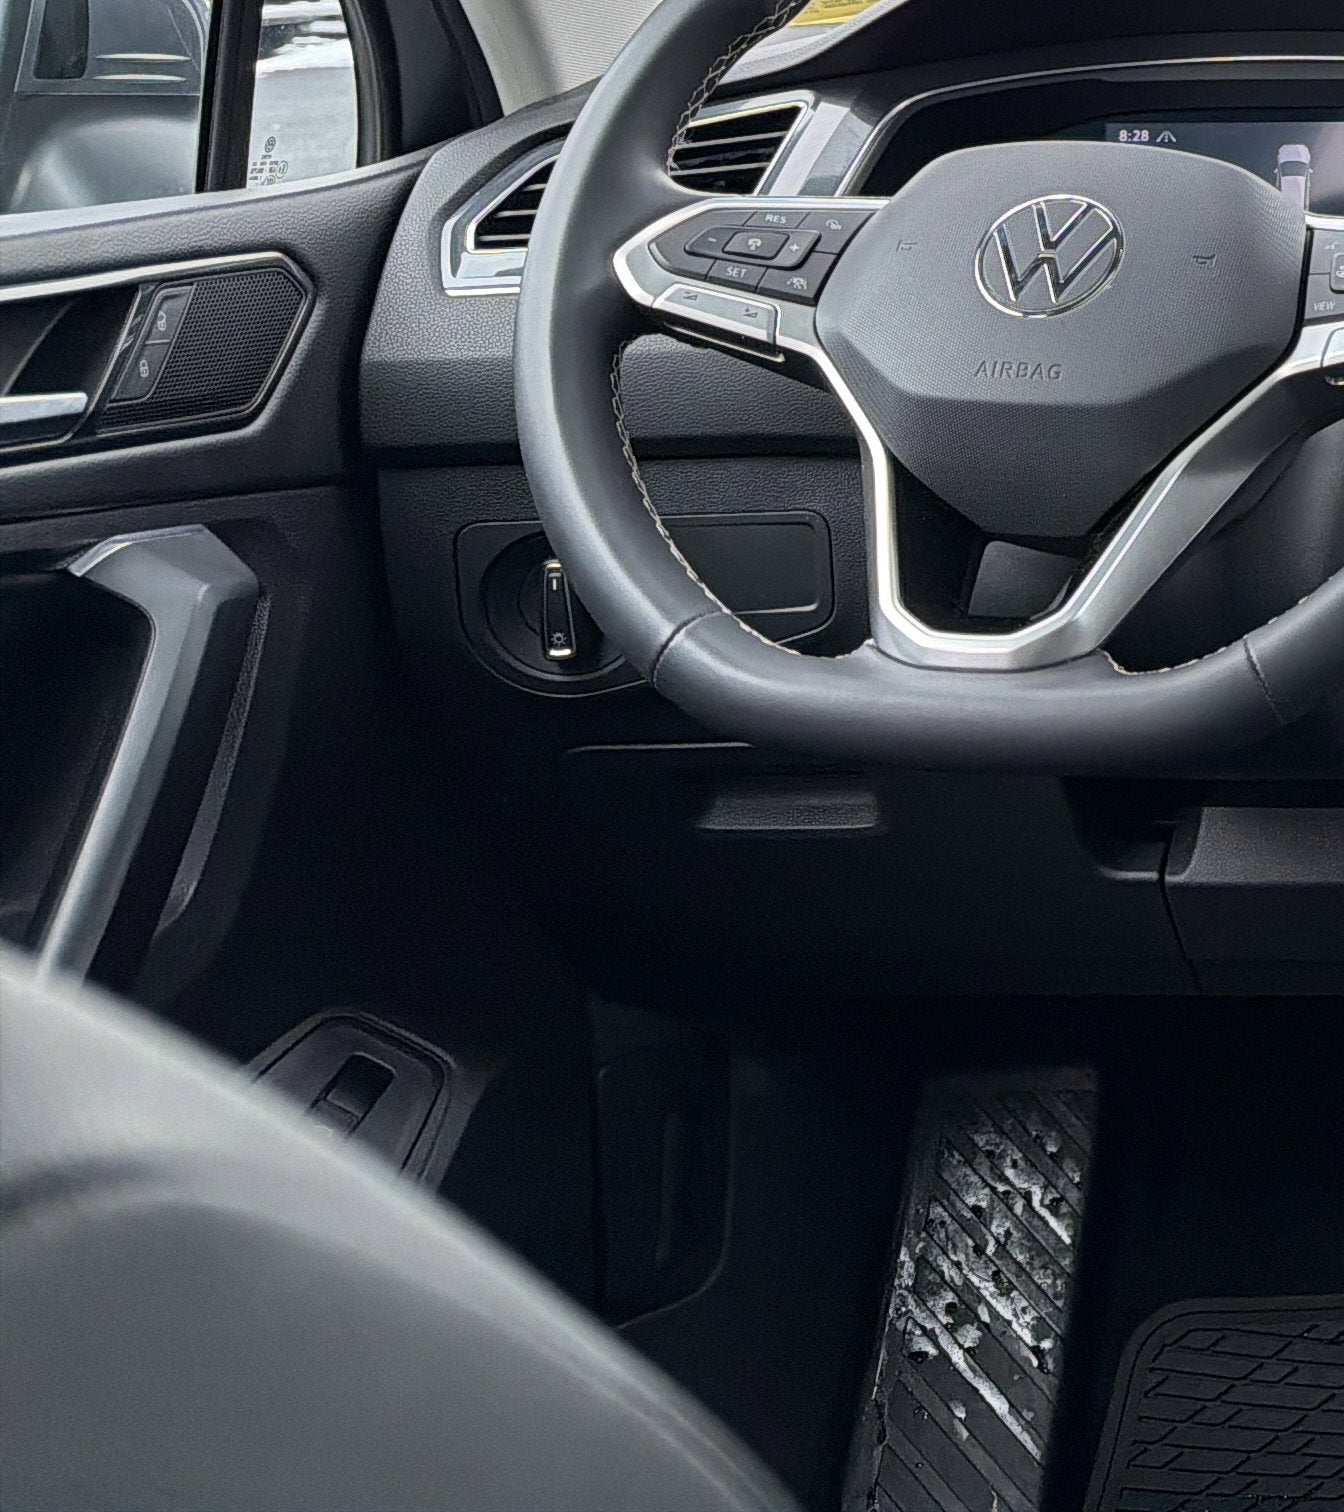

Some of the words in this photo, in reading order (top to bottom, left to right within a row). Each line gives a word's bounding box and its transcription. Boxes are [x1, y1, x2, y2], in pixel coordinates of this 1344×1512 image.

[1119, 129, 1150, 142] 8:28
[765, 214, 787, 225] RES
[725, 266, 747, 278] SET
[1313, 300, 1336, 311] VIEW
[974, 359, 1062, 380] AIRBAG
